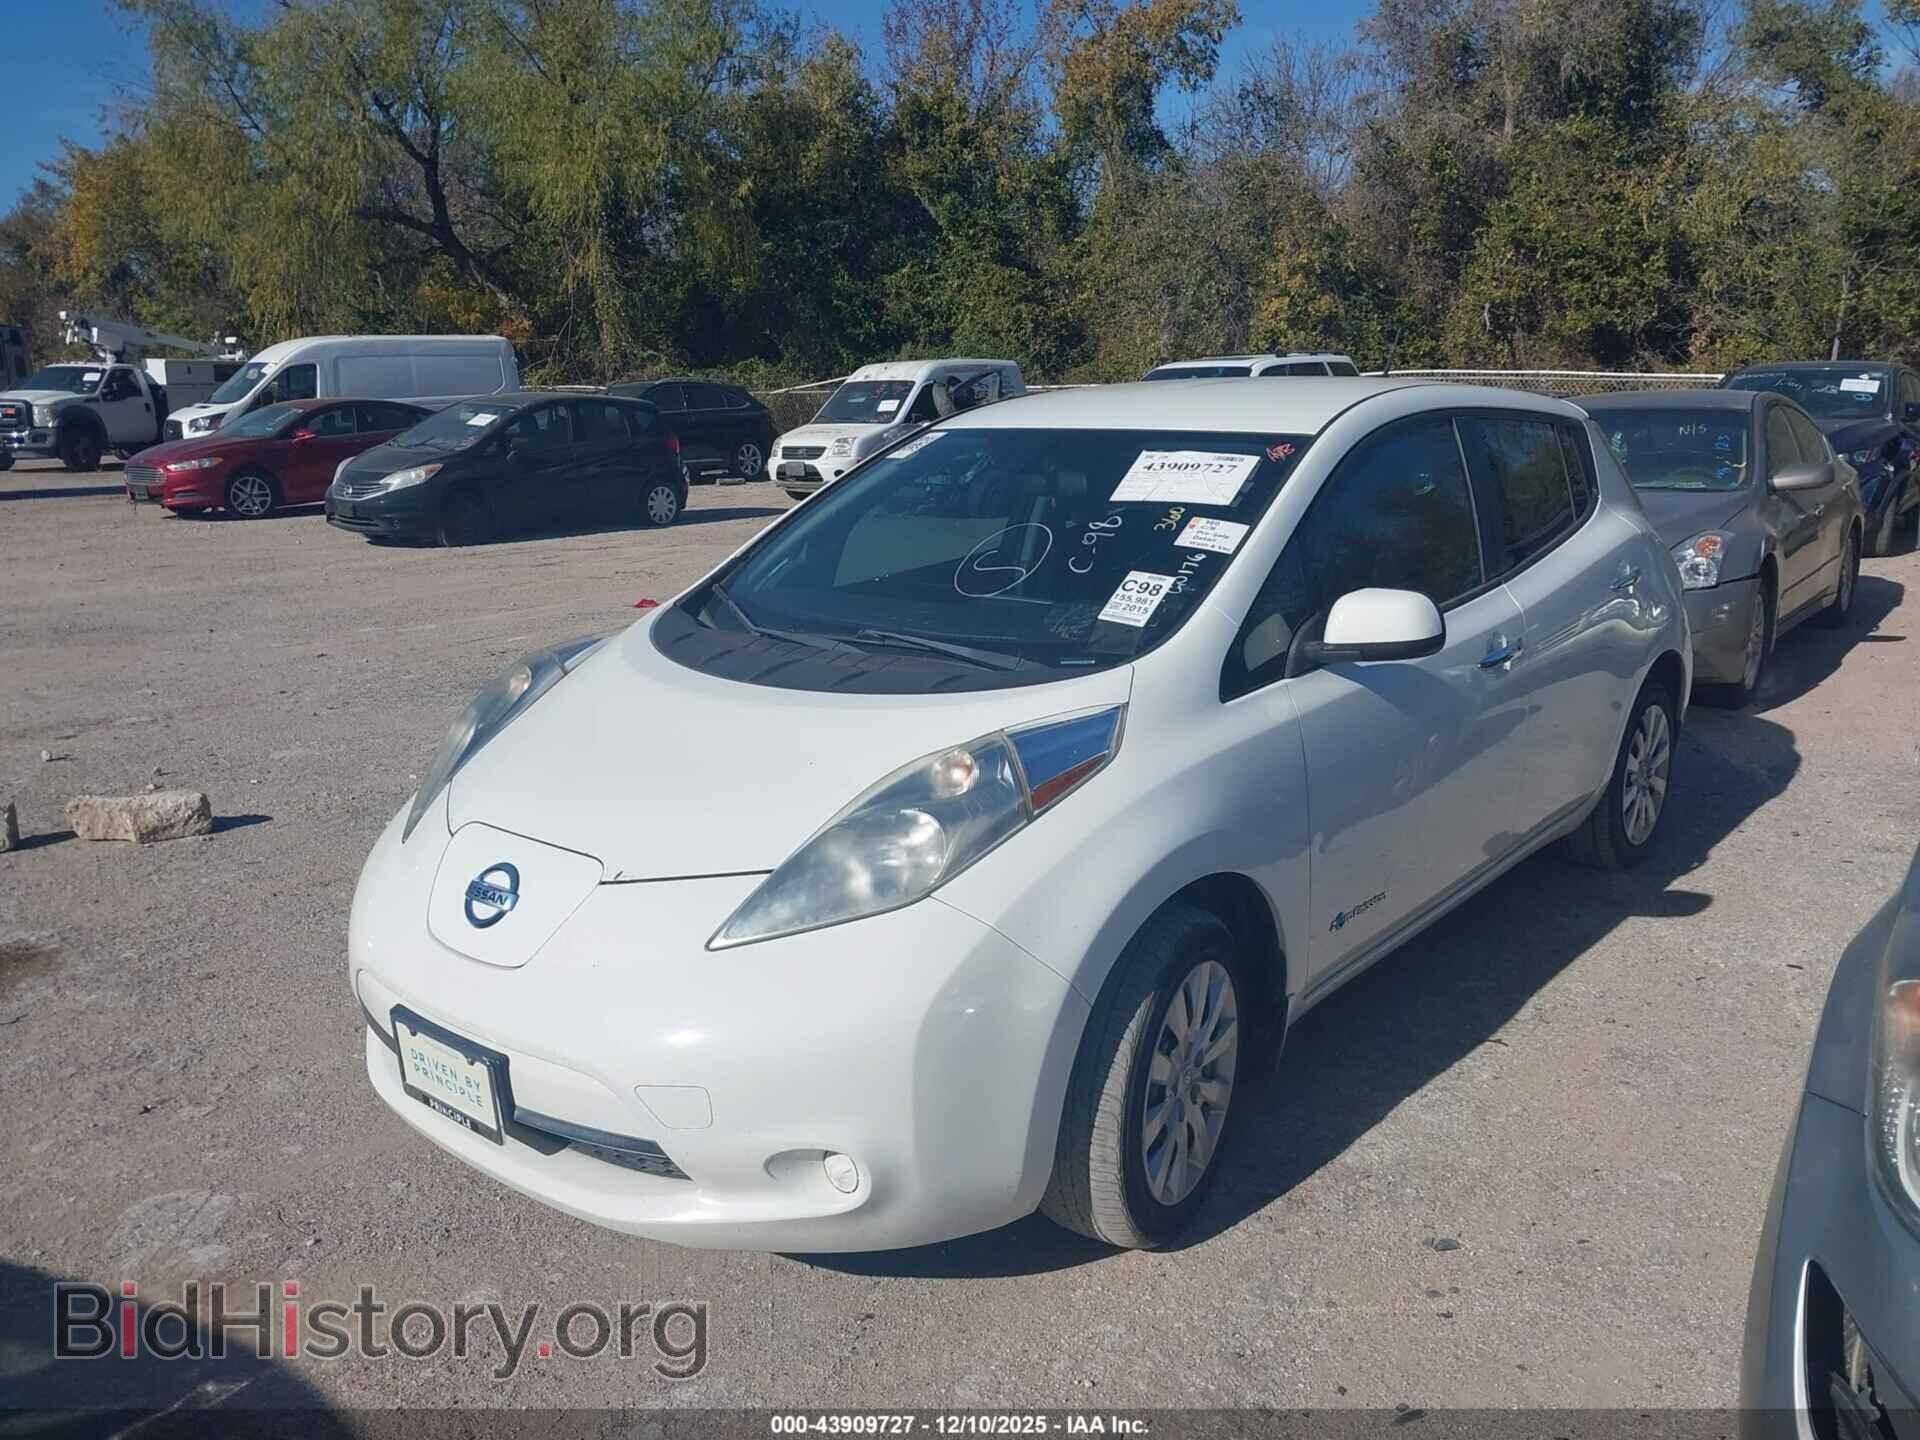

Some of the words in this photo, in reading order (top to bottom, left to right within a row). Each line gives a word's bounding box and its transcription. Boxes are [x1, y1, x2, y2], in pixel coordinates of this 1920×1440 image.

[1142, 460, 1238, 474] 43909727
[1068, 515, 1123, 574] C-98
[1121, 579, 1164, 597] C98
[1122, 603, 1150, 615] 2015
[469, 884, 510, 906] SSAN
[410, 1047, 459, 1082] DRIVEN
[464, 1075, 481, 1090] BY
[415, 1062, 485, 1108] PRINCIPLE
